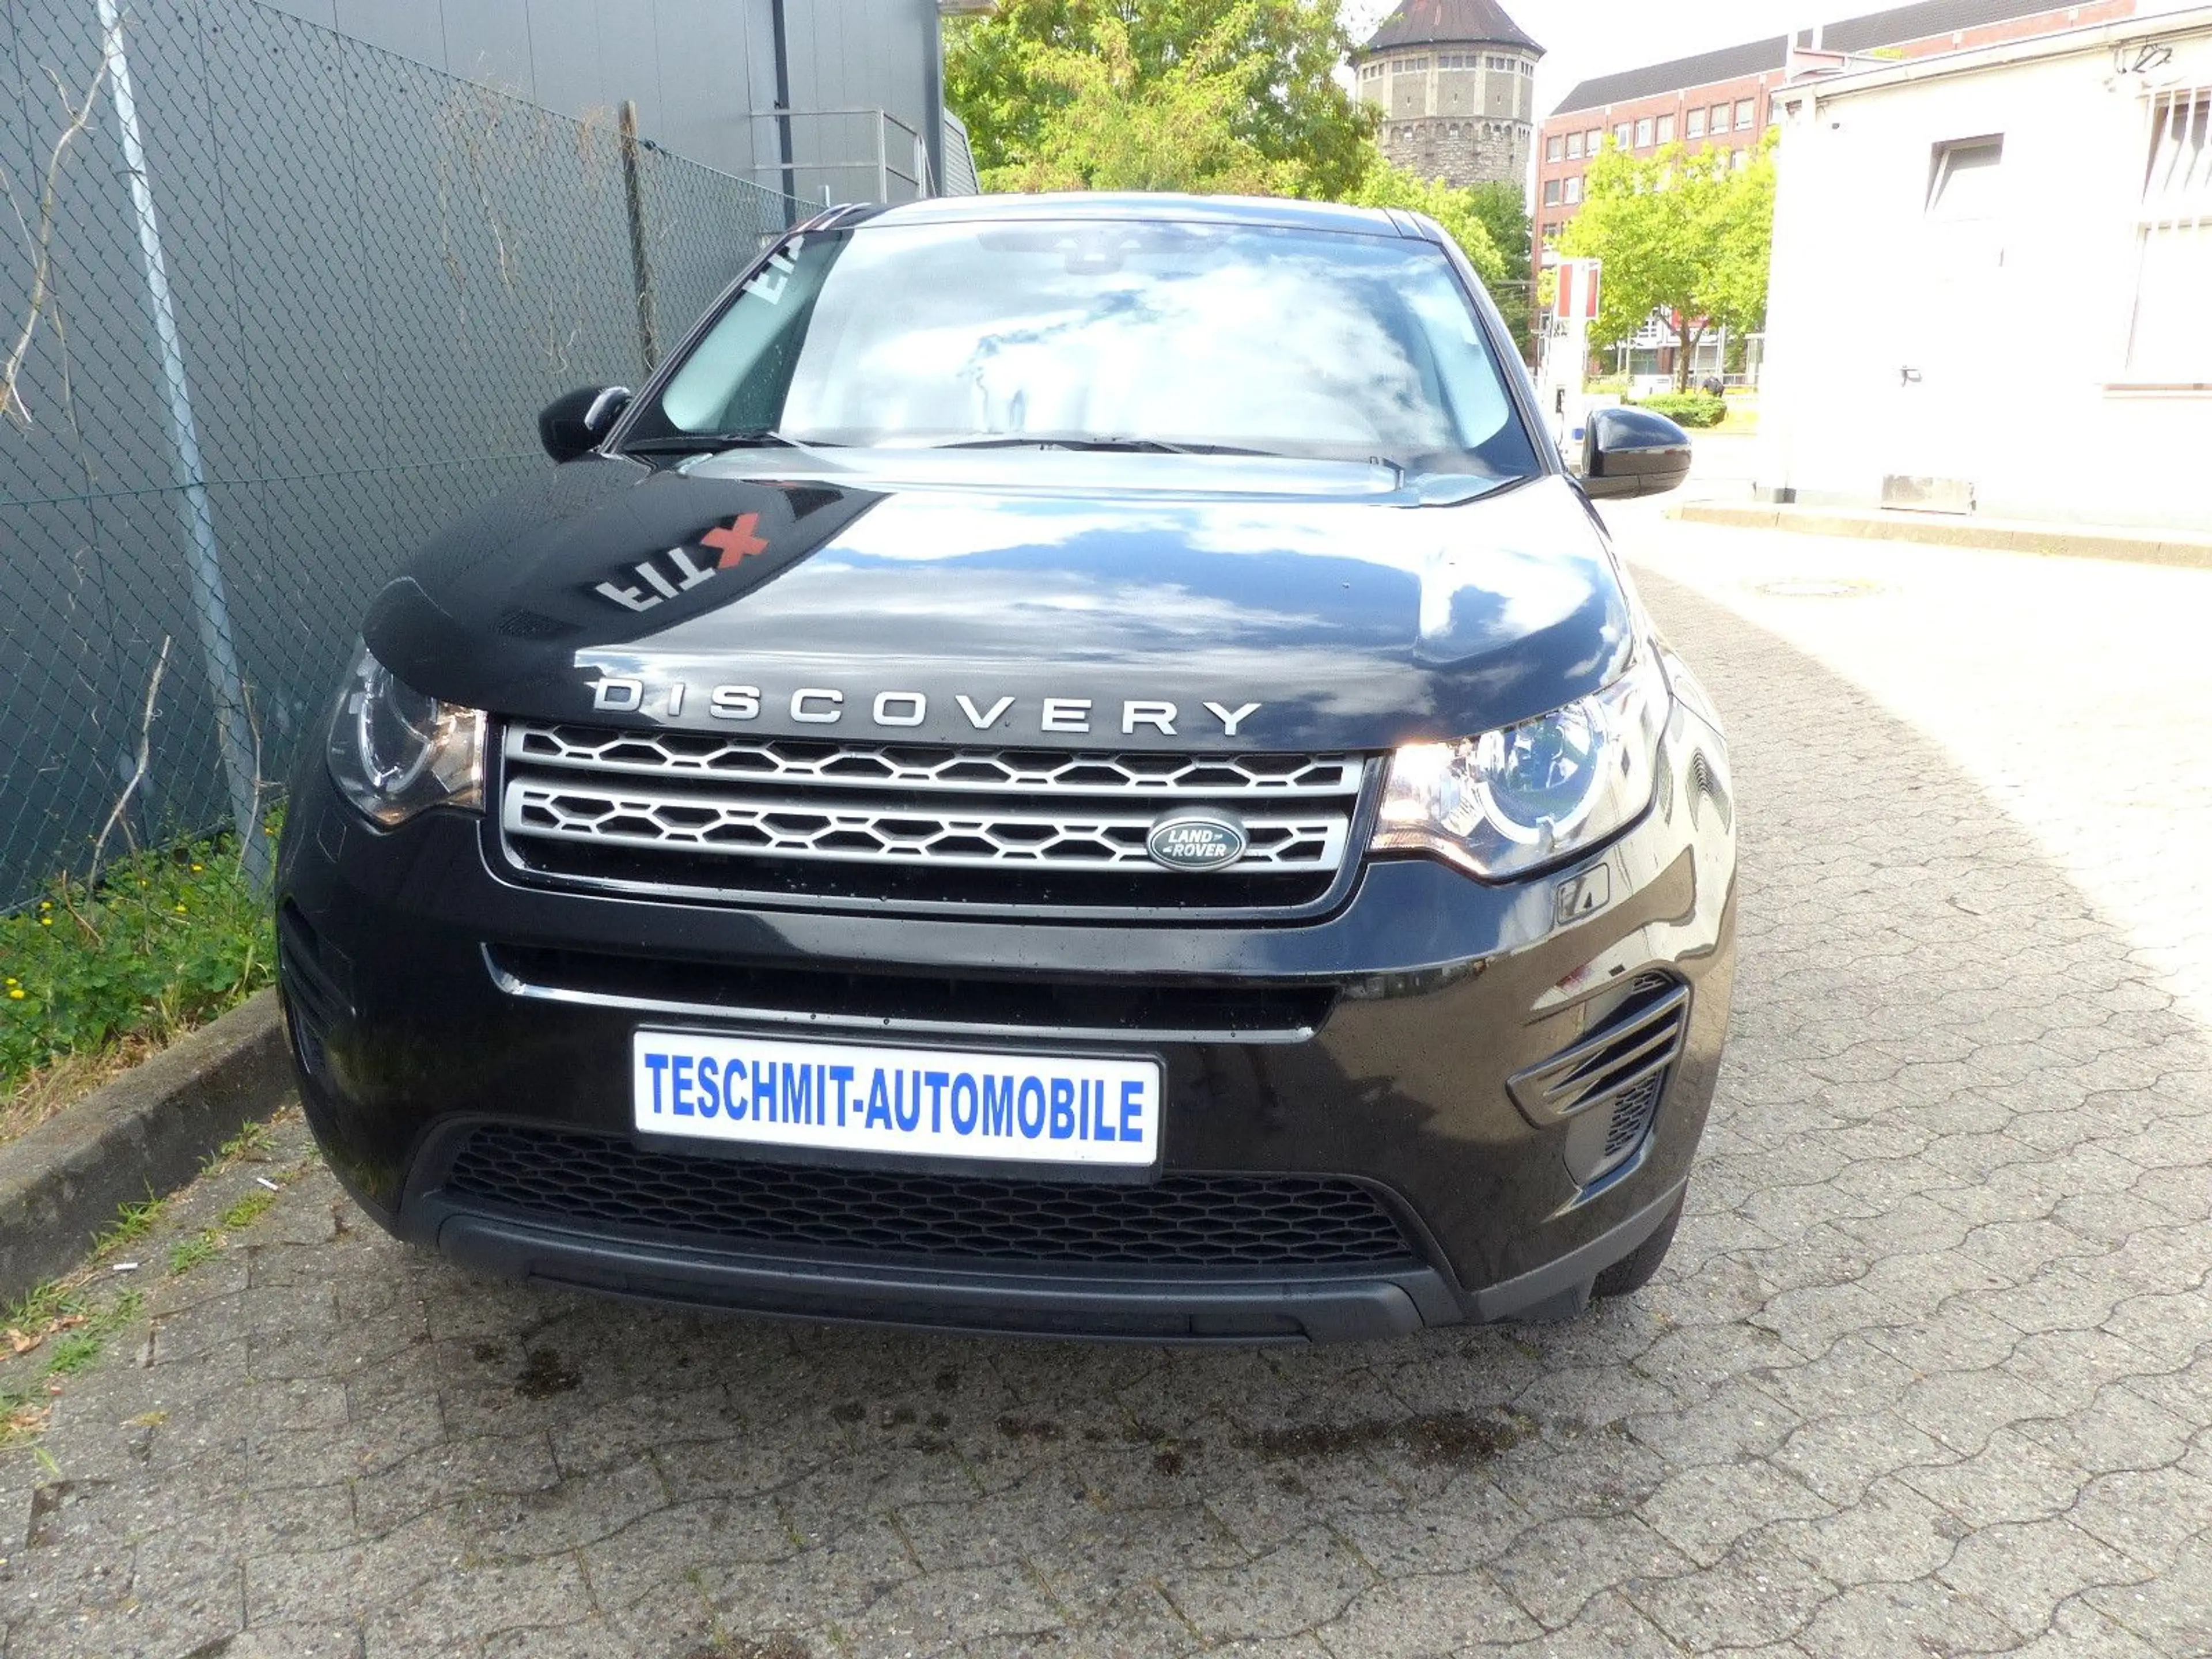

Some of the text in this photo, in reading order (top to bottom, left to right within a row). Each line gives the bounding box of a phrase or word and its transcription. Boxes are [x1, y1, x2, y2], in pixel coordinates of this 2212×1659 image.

[594, 678, 1262, 736] DISCOVERY
[1168, 830, 1213, 843] LAND
[1172, 843, 1228, 857] ROVER
[645, 1054, 1144, 1142] TESCHMIT-AUTOMOBILE
